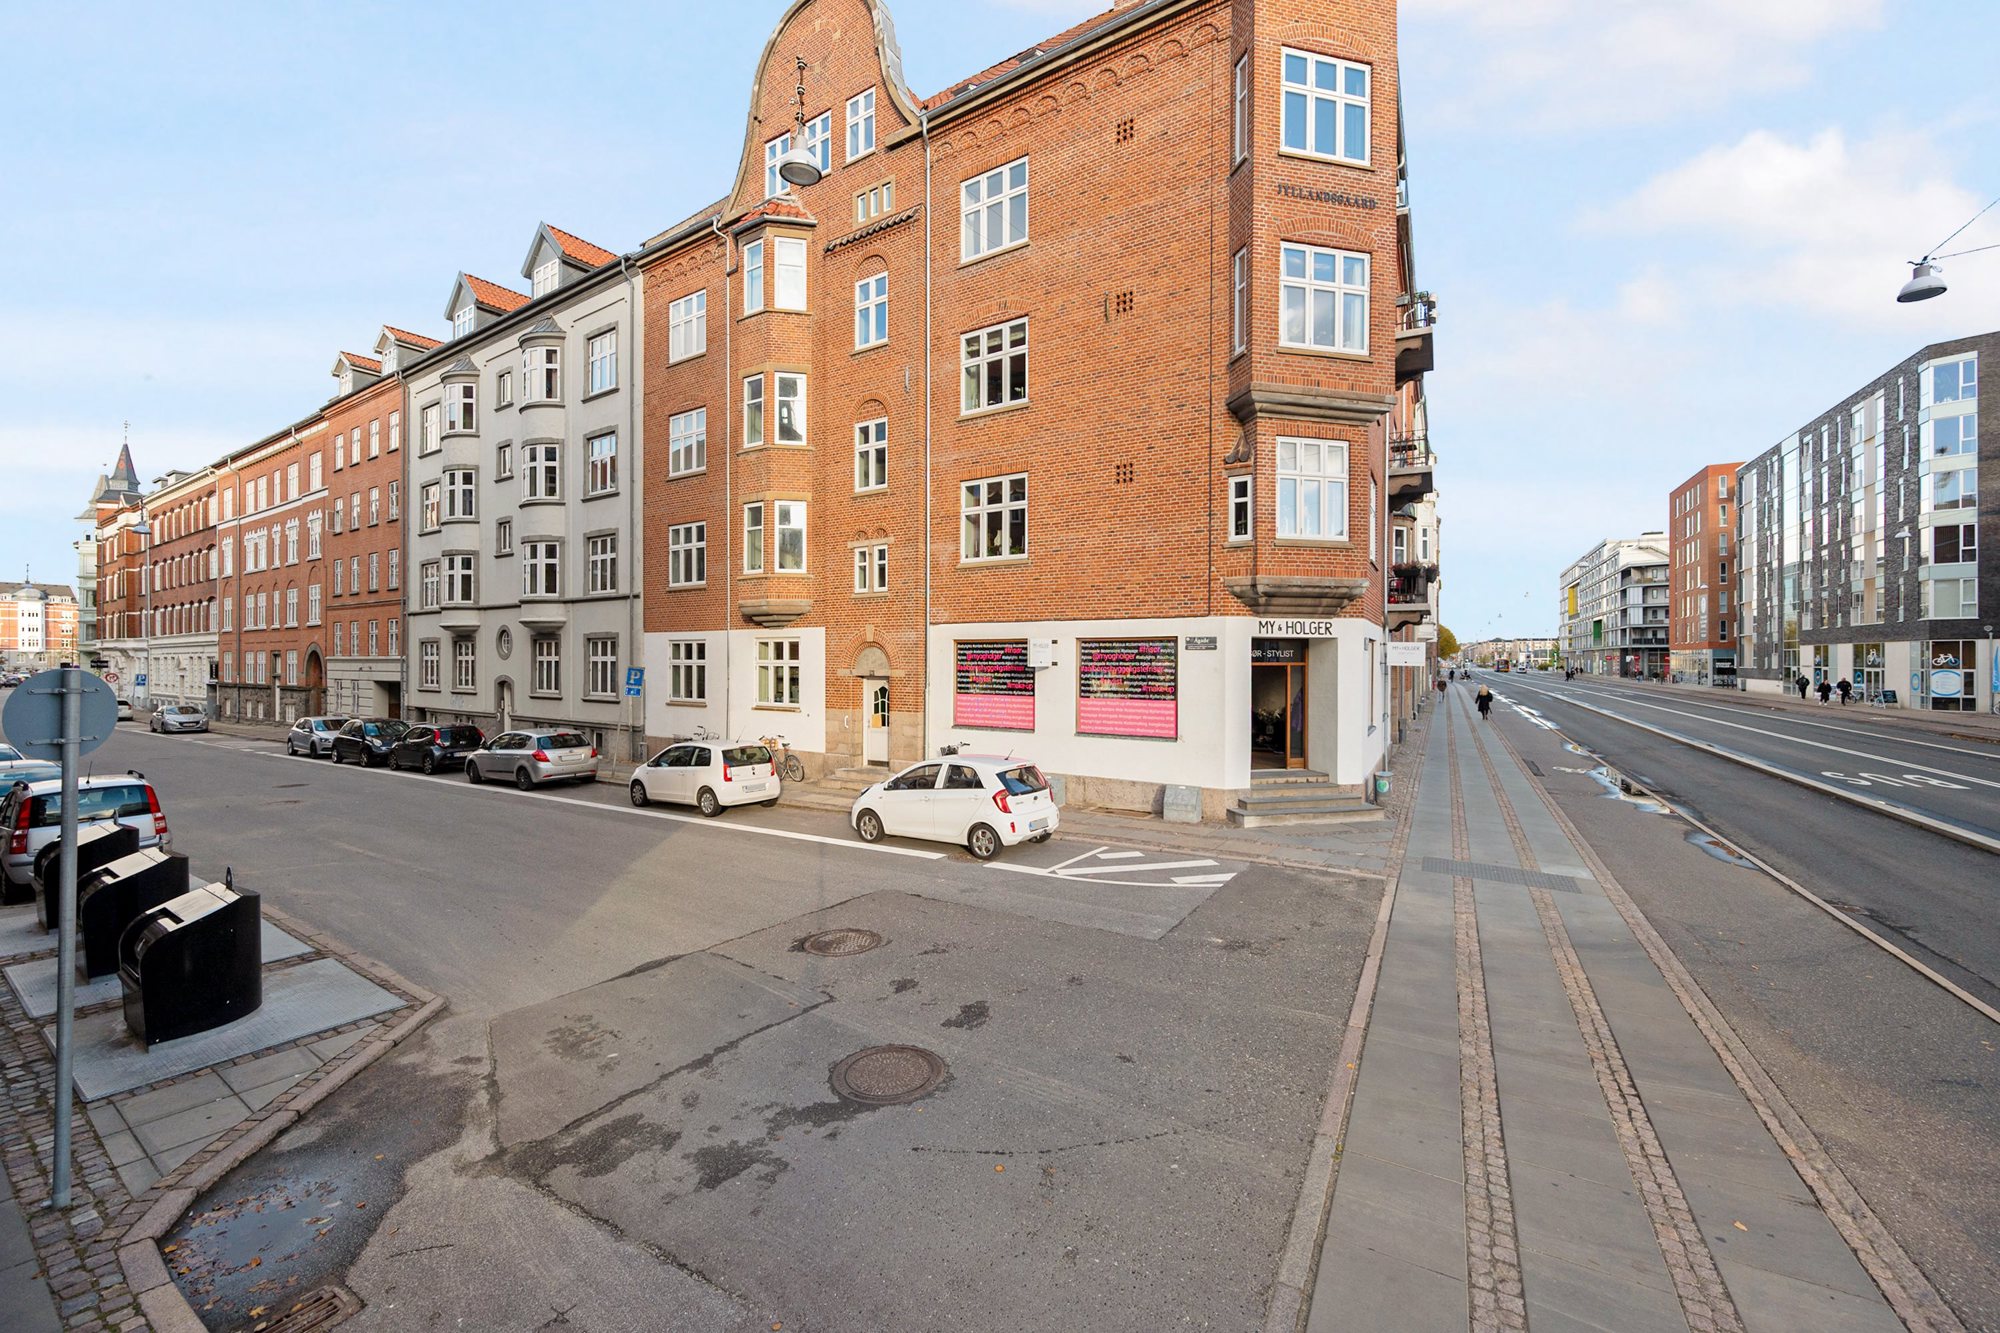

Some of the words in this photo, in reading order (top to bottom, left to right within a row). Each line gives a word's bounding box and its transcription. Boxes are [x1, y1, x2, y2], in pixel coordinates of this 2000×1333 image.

[1277, 184, 1376, 210] JYLLANDSGAARD
[1258, 621, 1275, 634] MY
[1286, 621, 1332, 635] HOLGER
[630, 670, 640, 683] P
[1821, 771, 1972, 790] BUS
